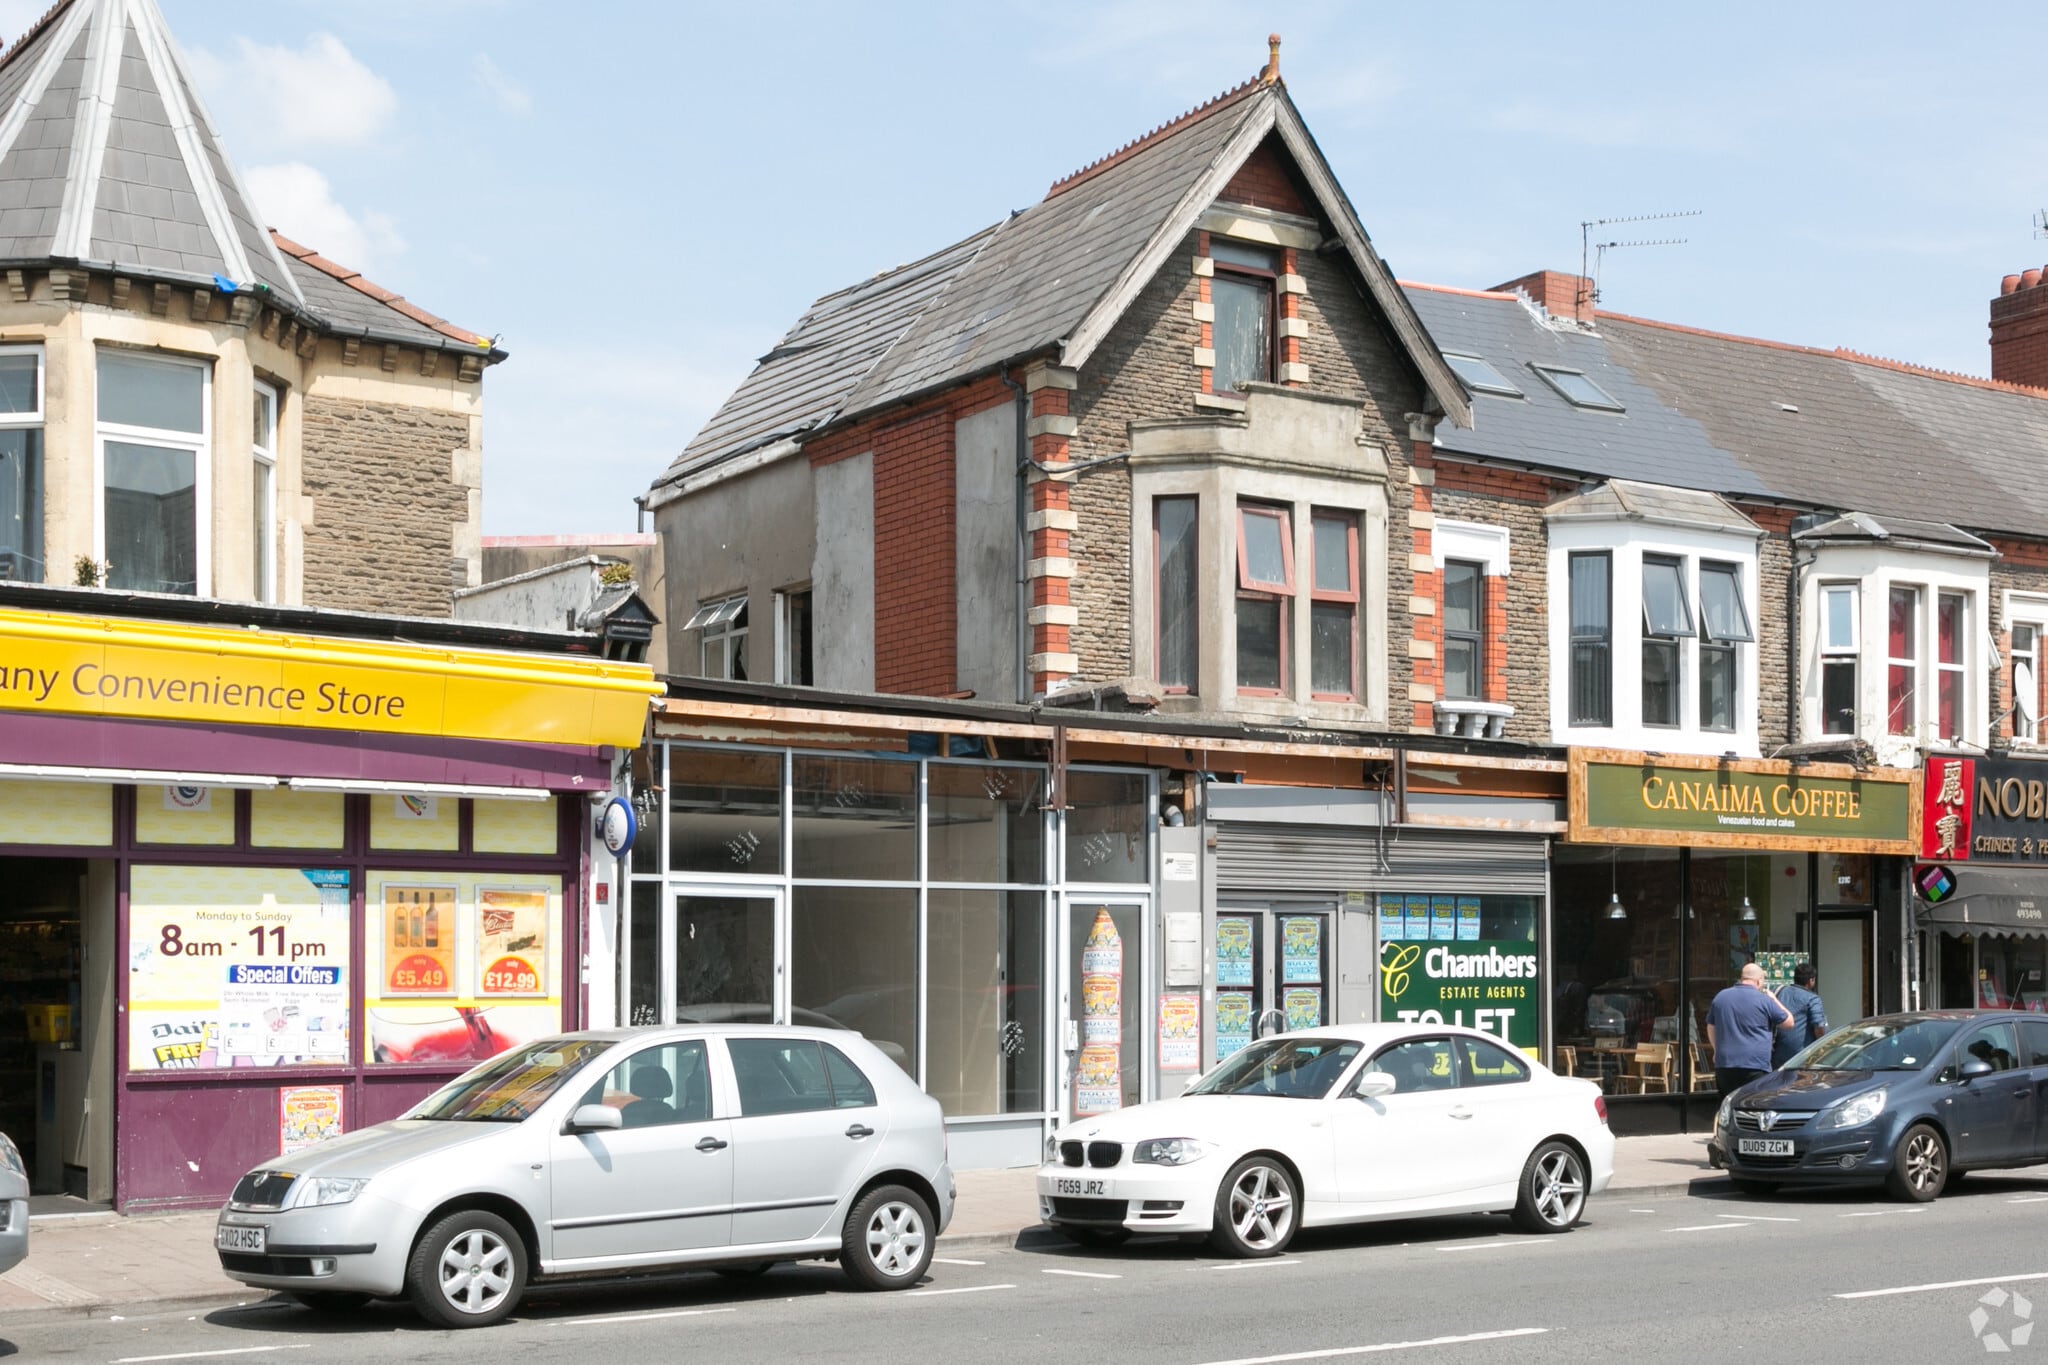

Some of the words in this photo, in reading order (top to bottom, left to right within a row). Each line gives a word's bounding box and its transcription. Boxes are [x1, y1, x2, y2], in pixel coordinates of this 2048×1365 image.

[72, 663, 305, 711] Convenience
[316, 682, 405, 718] Store
[1642, 776, 1766, 814] CANAIMA
[1772, 784, 1861, 819] COFFEE
[1752, 816, 1765, 826] food
[1766, 818, 1777, 827] and
[1778, 818, 1796, 828] cakes
[1975, 836, 2017, 853] CHINESE
[2021, 838, 2034, 855] &
[196, 912, 238, 923] Monday
[241, 912, 253, 921] to
[255, 912, 292, 923] Sunday
[2016, 908, 2042, 920] 493490
[160, 924, 223, 957] 8am
[248, 925, 326, 962] 11pm
[1425, 945, 1537, 979] Chambers
[237, 965, 288, 984] Special
[291, 966, 333, 984] Offers
[396, 969, 443, 987] £5.49
[485, 972, 536, 988] £12.99
[1440, 986, 1480, 999] ESTATE
[1487, 986, 1526, 998] AGENTS
[1742, 1140, 1766, 1153] DU09
[1768, 1141, 1789, 1153] ZGW
[1058, 1179, 1081, 1194] FG59
[1084, 1180, 1104, 1195] JRZ
[240, 1229, 260, 1249] HSC
